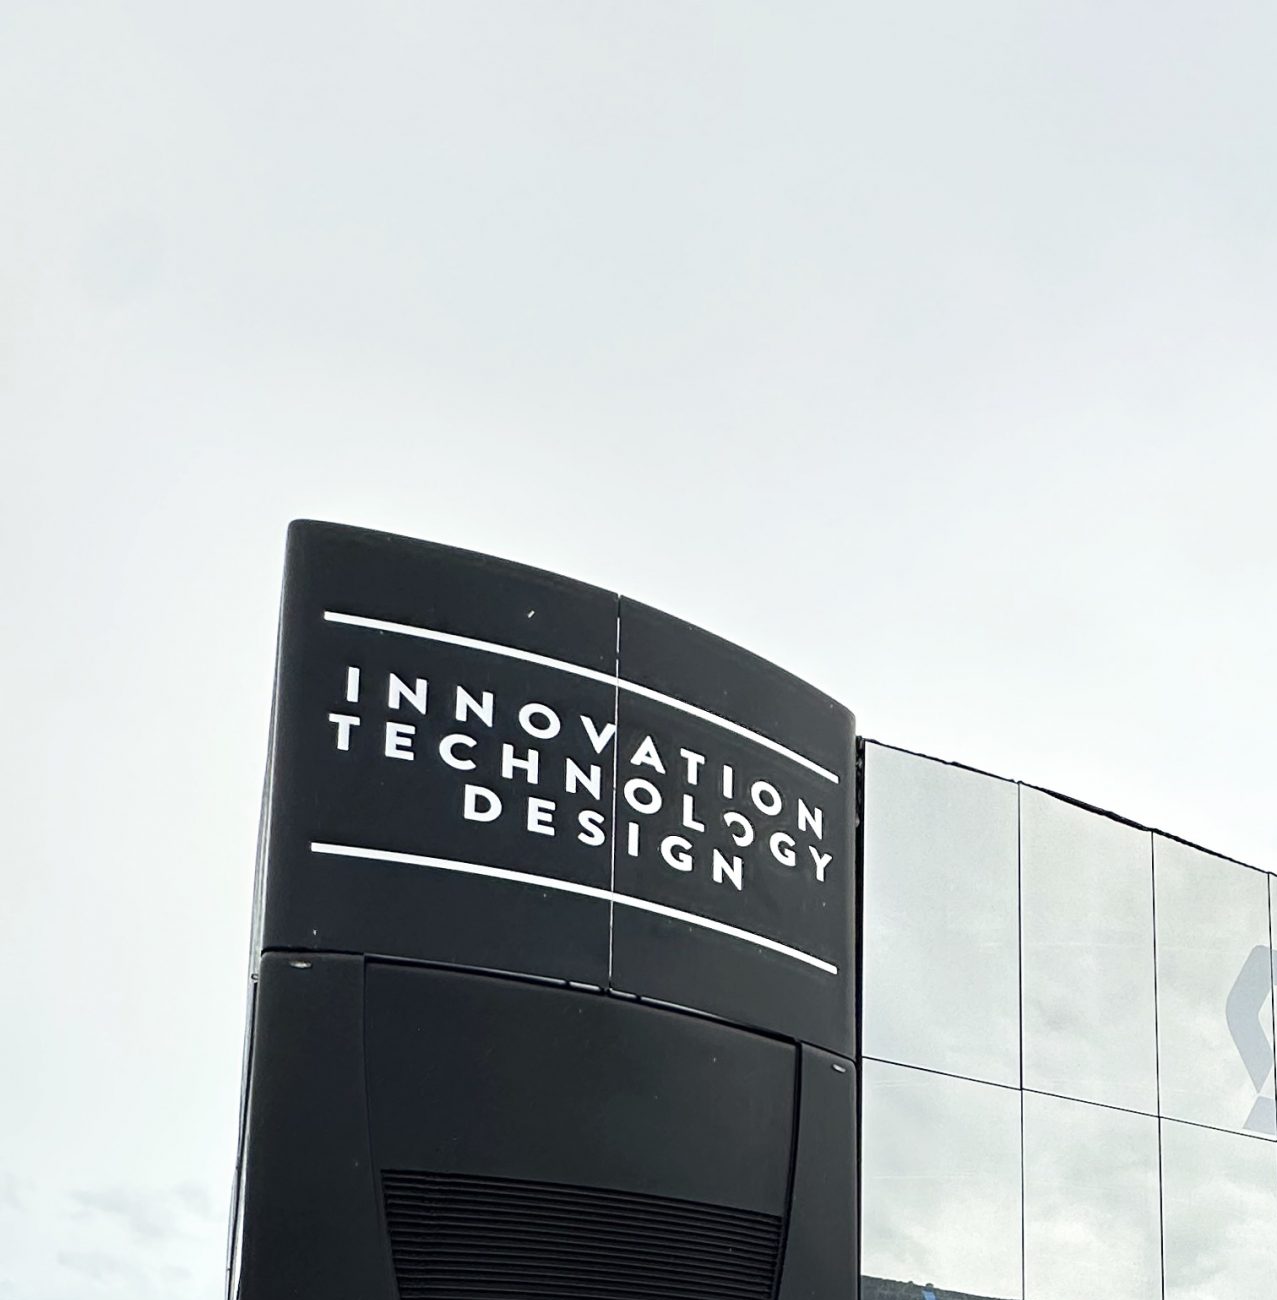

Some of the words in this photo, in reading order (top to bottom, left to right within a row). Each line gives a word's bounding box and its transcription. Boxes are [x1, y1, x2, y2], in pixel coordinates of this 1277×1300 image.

[328, 713, 832, 883] TECHNOLOGY
[347, 666, 824, 841] INNOVATION
[463, 784, 743, 891] DESIGN
